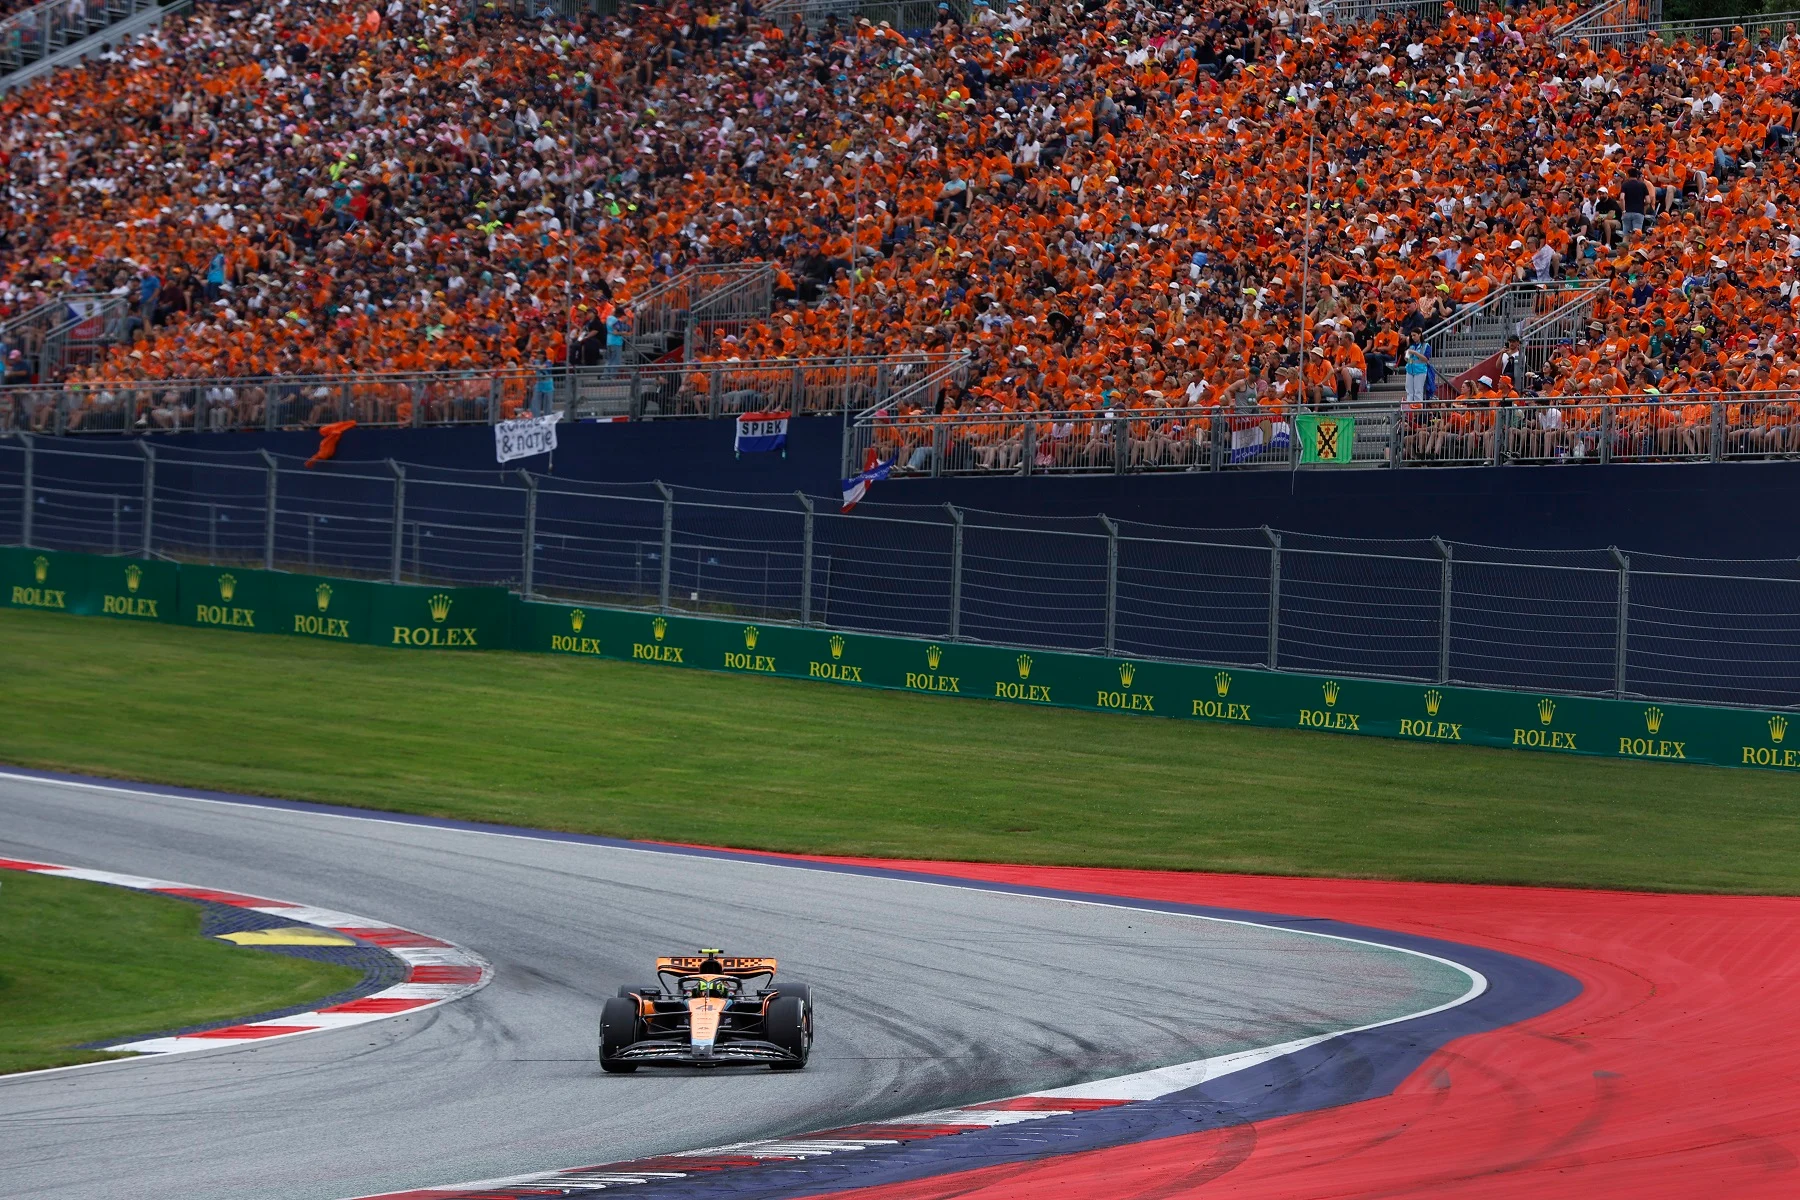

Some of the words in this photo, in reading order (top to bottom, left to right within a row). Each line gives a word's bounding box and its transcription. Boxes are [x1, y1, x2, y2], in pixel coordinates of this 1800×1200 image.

[502, 435, 513, 454] &
[12, 587, 65, 608] ROLEX
[103, 595, 157, 617] ROLEX
[197, 605, 254, 626] ROLEX
[295, 615, 348, 637] ROLEX
[392, 626, 477, 646] ROLEX
[551, 635, 601, 654] ROLEX
[632, 643, 683, 663] ROLEX
[723, 652, 776, 672] ROLEX
[808, 662, 862, 682] ROLEX
[905, 673, 959, 692] ROLEX
[995, 682, 1051, 702] ROLEX
[1097, 691, 1154, 711] ROLEX
[1192, 700, 1250, 720] ROLEX
[1299, 710, 1359, 730] ROLEX
[1399, 719, 1462, 739] ROLEX
[1513, 729, 1577, 749] ROLEX
[1619, 738, 1686, 759] ROLEX
[1741, 746, 1800, 768] ROLE
